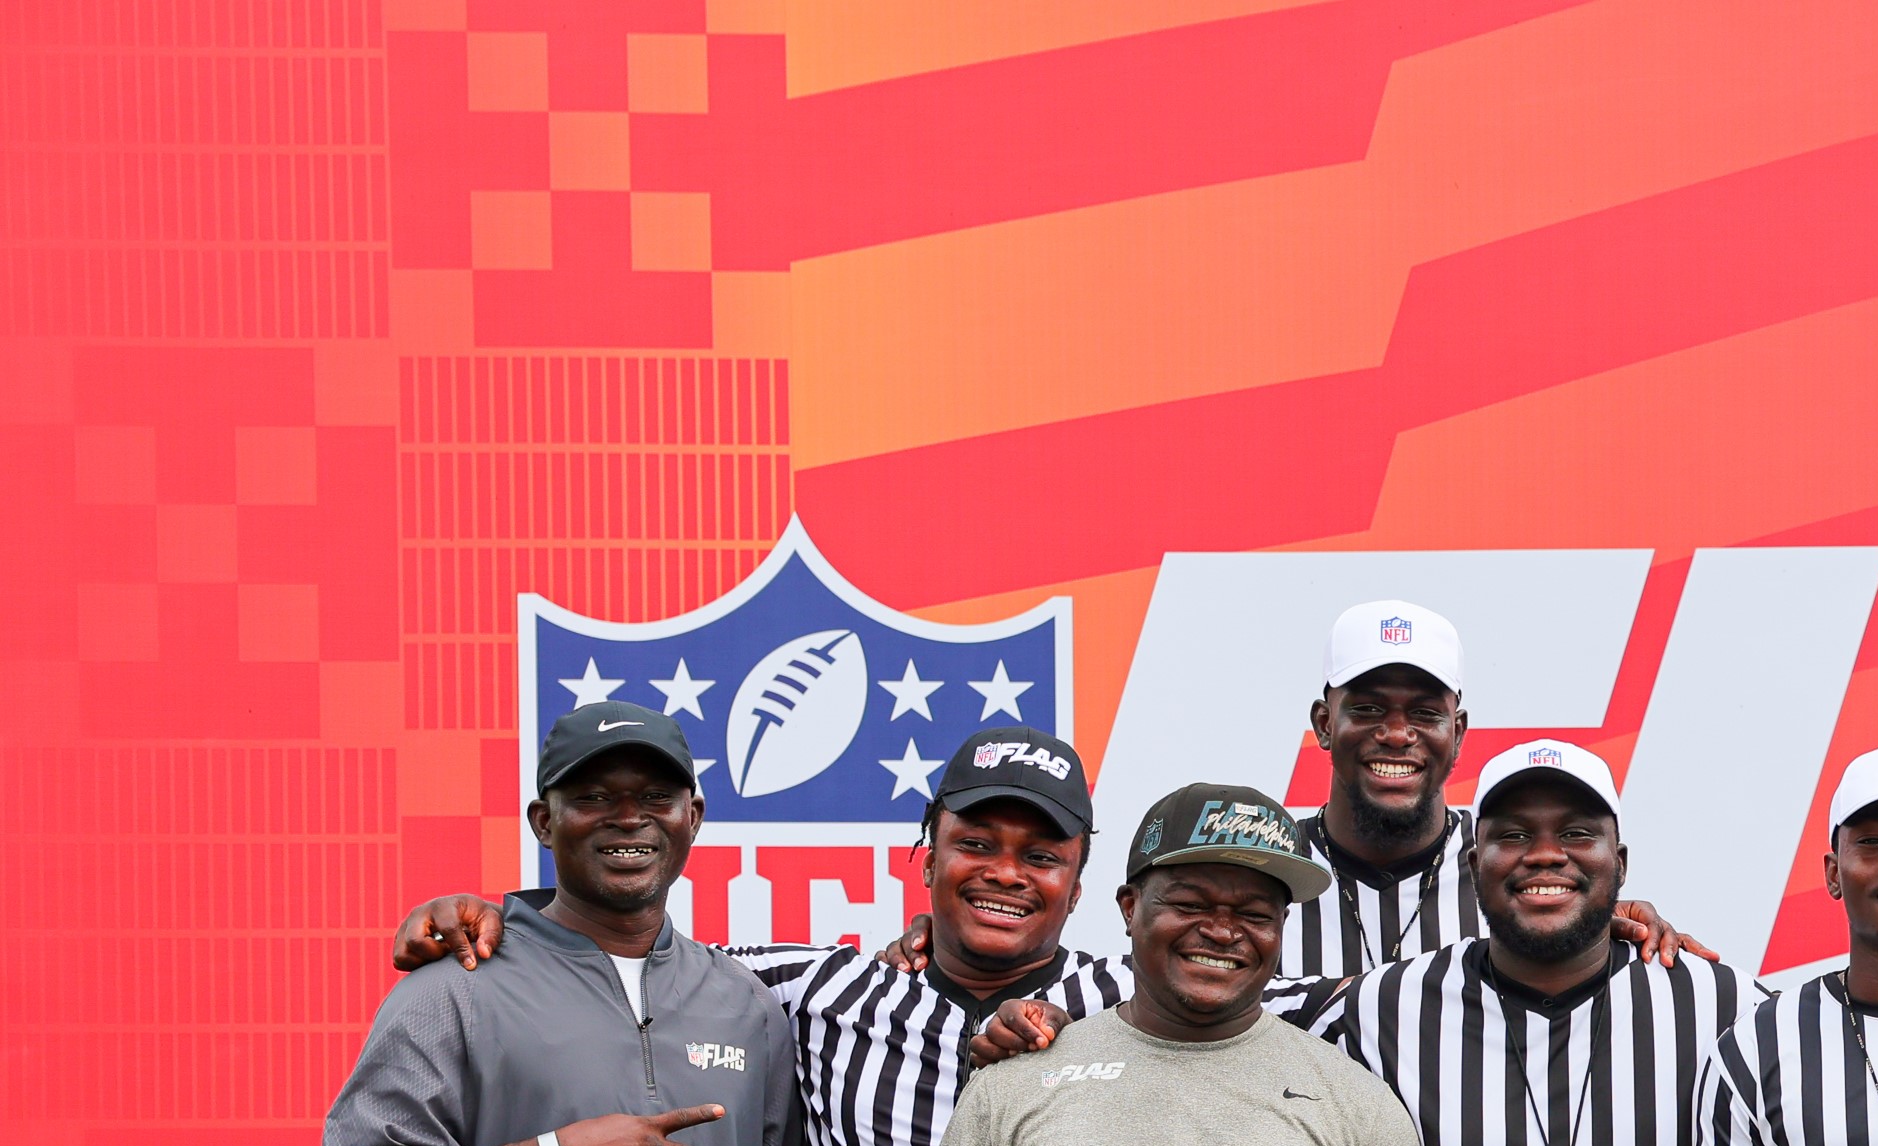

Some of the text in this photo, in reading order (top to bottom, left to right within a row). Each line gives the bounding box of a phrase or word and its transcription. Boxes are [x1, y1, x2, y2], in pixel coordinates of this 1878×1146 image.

[1384, 628, 1409, 641] NFL
[990, 742, 1072, 780] FLAG
[1532, 756, 1559, 767] NFL
[1203, 811, 1297, 854] Philadelphia
[702, 1043, 746, 1071] FLAG
[1052, 1062, 1125, 1085] FLAG
